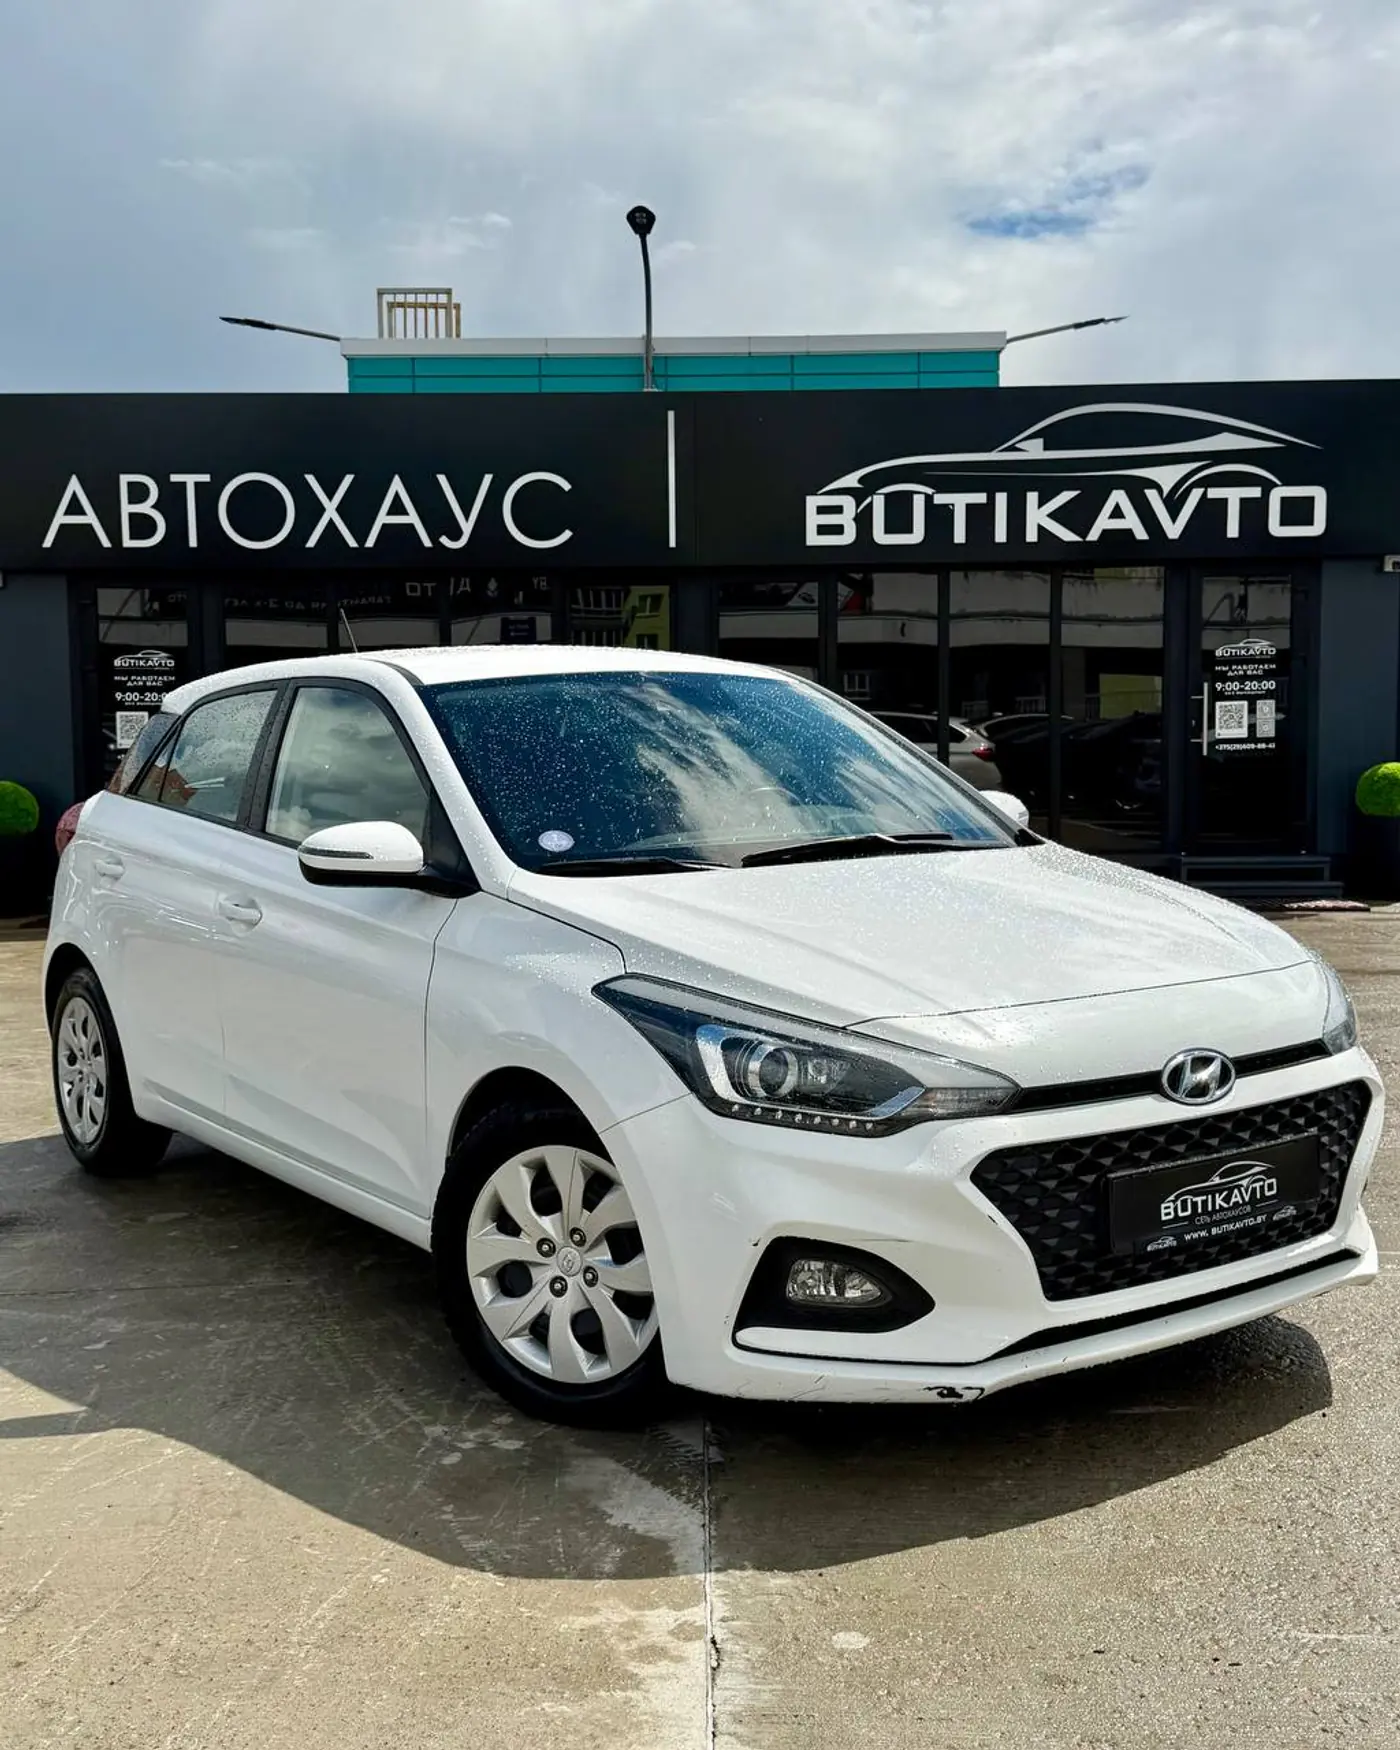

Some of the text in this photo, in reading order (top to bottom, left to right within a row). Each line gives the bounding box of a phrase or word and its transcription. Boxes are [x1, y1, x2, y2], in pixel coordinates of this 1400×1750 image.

[42, 471, 574, 551] АВТОХАУС
[805, 485, 1327, 546] BUTIKAVTO
[114, 659, 175, 667] BUTIKAVTO
[1215, 647, 1276, 657] BUTIKAVTO
[1215, 680, 1276, 691] 9:00-20:00
[1160, 1178, 1277, 1221] BUTIKAVTO
